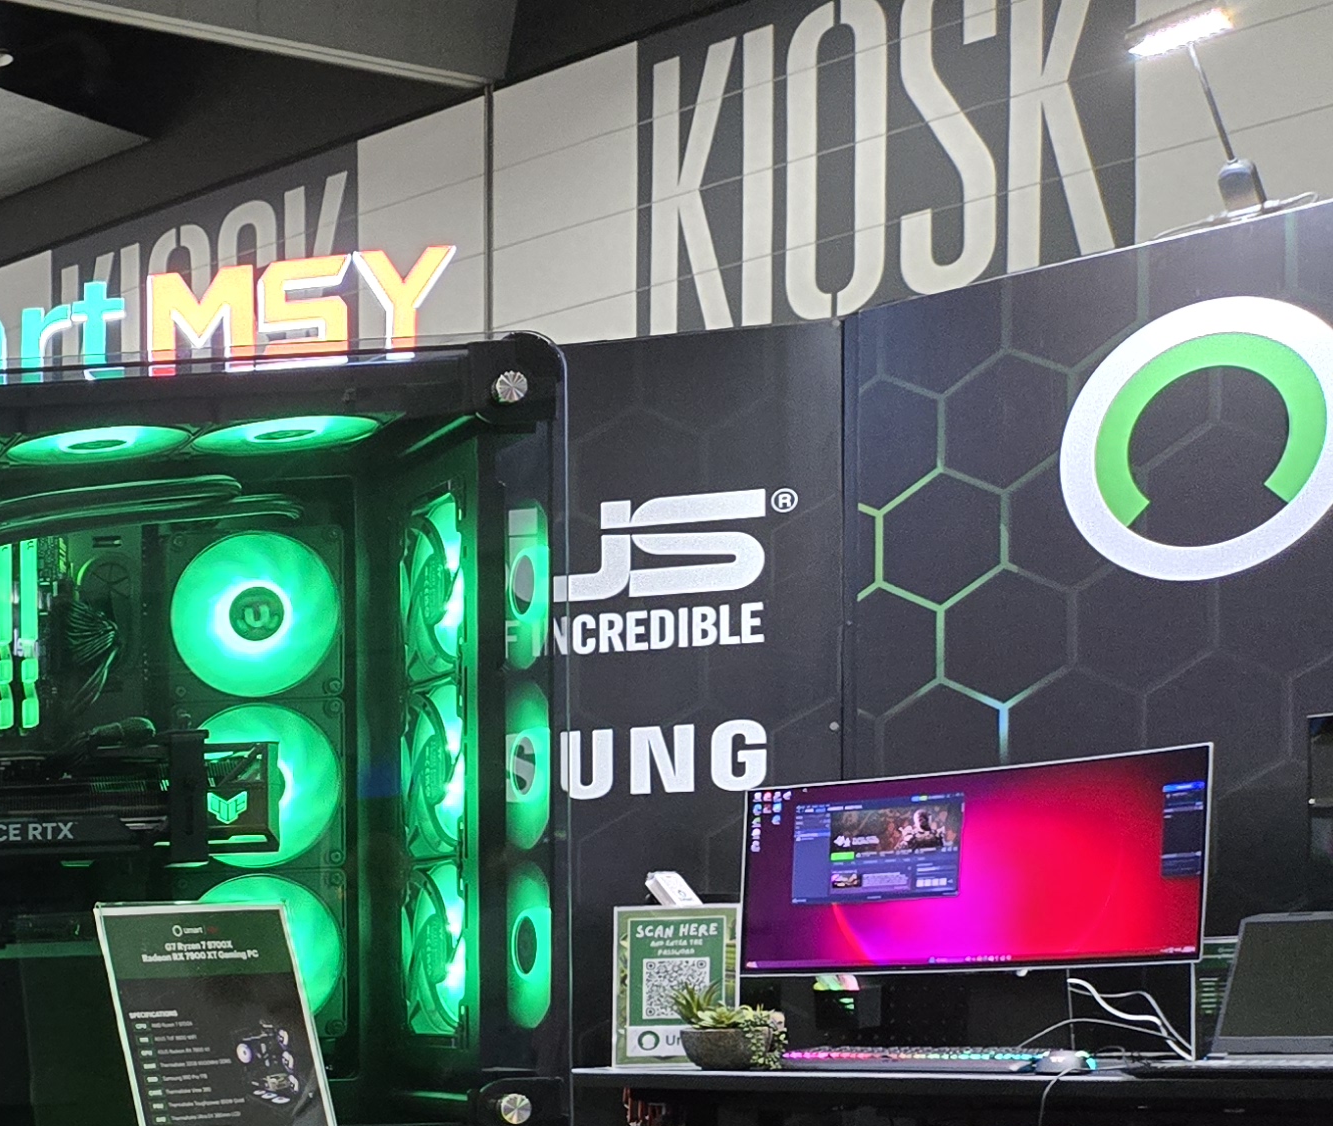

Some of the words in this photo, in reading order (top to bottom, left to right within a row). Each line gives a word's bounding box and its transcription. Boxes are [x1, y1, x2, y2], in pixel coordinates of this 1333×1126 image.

[650, 0, 1116, 336] KIOSK
[146, 245, 457, 376] MSY
[505, 718, 768, 801] SUNG
[27, 821, 74, 841] RTX
[635, 924, 675, 939] SCAN
[678, 922, 719, 938] HERE
[689, 938, 704, 947] THE
